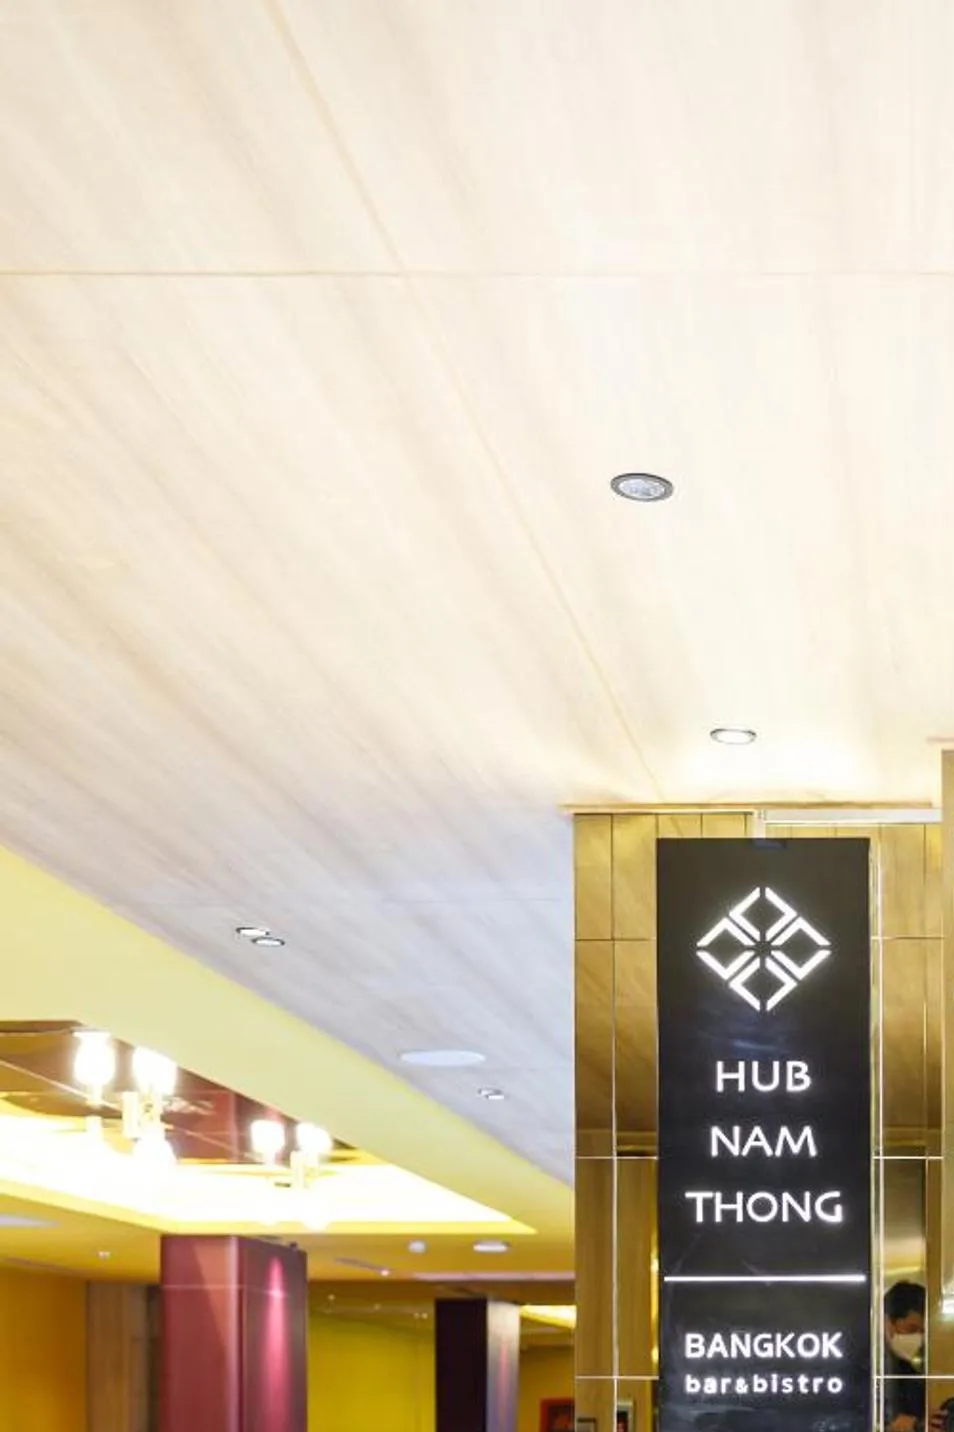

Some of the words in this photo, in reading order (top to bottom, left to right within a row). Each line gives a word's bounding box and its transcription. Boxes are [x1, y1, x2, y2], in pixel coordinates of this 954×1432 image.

[715, 1060, 812, 1093] HUB
[710, 1125, 817, 1157] NAM
[685, 1191, 843, 1223] THONG
[685, 1332, 843, 1358] BANGKOK
[685, 1373, 843, 1394] bar&bistro
